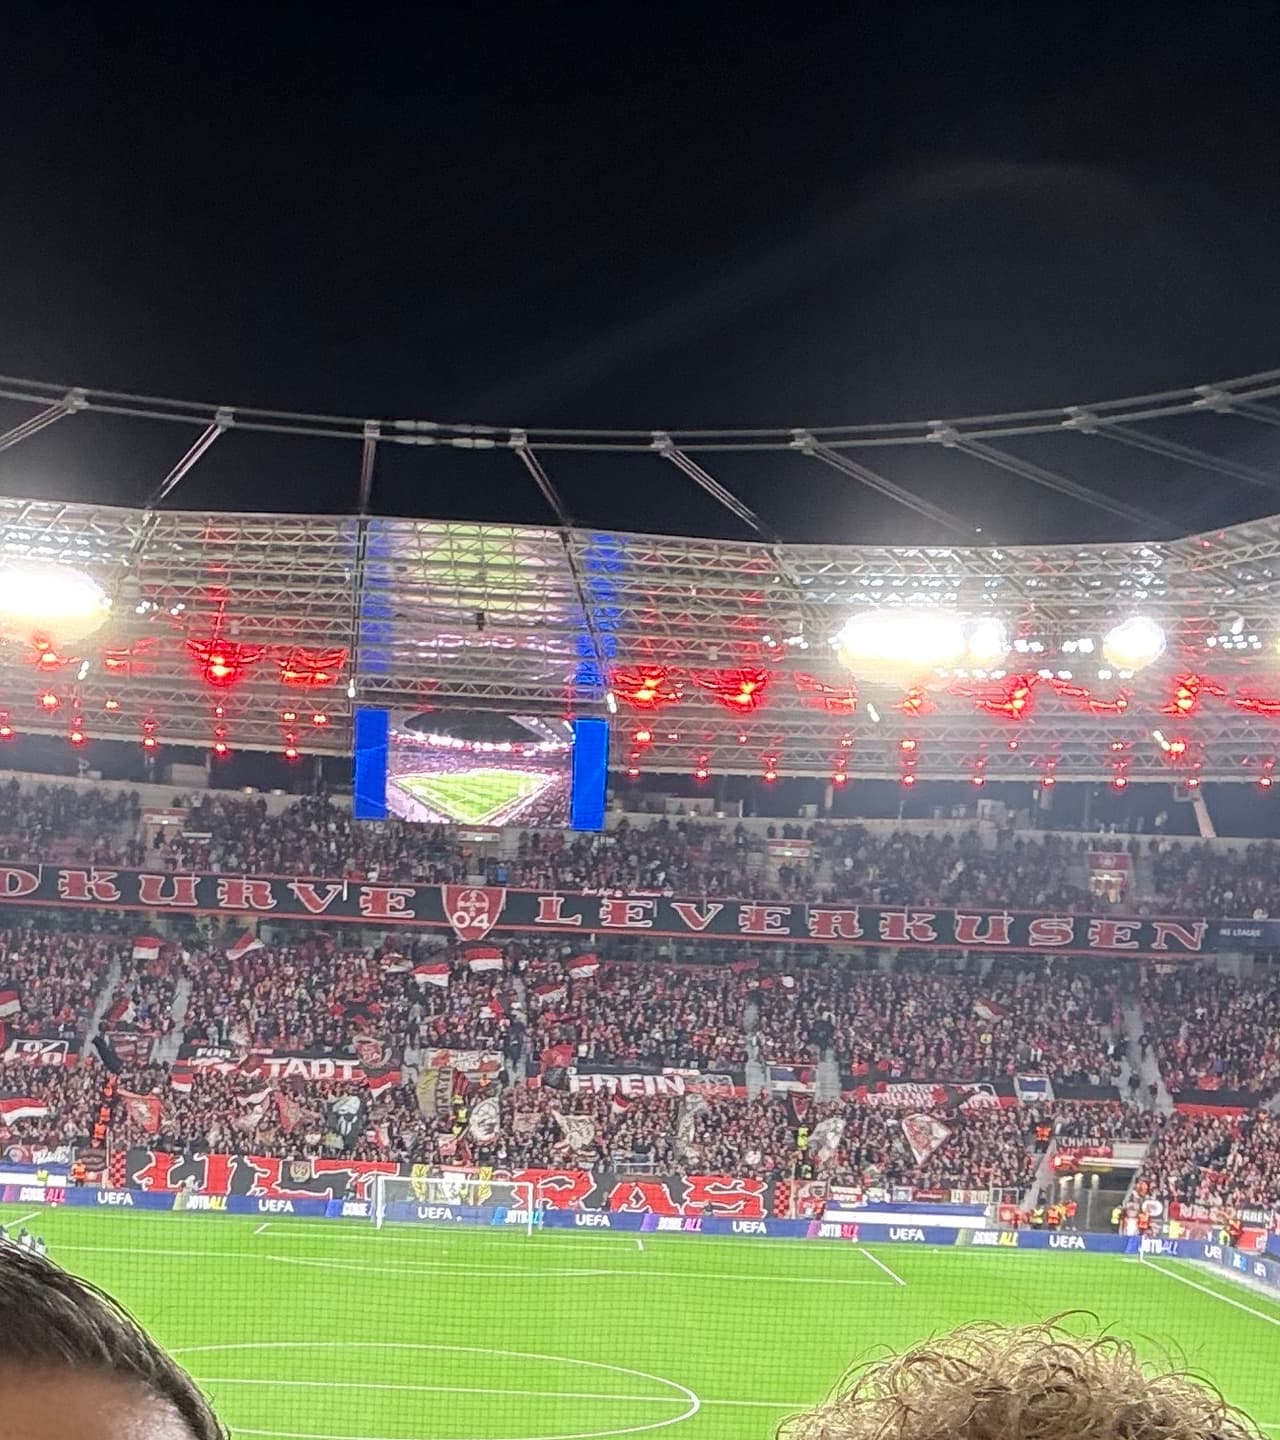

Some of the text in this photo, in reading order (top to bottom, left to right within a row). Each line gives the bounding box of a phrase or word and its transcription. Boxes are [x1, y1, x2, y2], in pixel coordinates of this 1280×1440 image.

[453, 911, 490, 929] 04
[534, 896, 1208, 951] LEVERKUSEN
[242, 1057, 361, 1081] TADT
[569, 1074, 685, 1098] EREIN
[97, 1191, 133, 1205] UEFA
[258, 1199, 294, 1213] UEFA
[418, 1206, 452, 1220] UEFA
[575, 1214, 610, 1227] UEFA
[732, 1220, 767, 1234] UEFA
[889, 1227, 925, 1241] UEFA
[1049, 1234, 1086, 1249] UEFA
